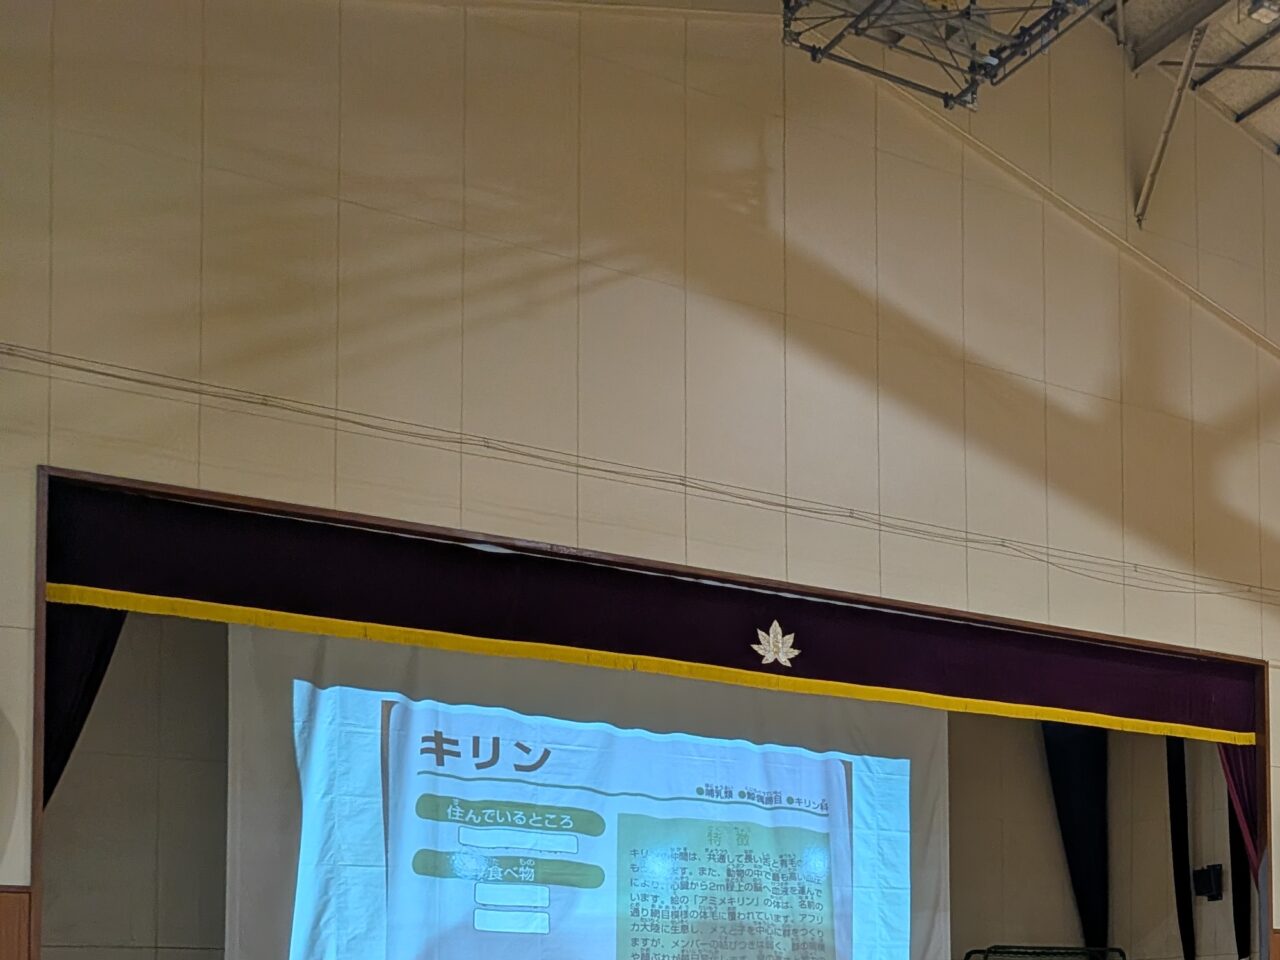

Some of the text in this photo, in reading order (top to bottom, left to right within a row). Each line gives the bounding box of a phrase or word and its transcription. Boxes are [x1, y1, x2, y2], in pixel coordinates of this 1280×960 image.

[420, 729, 551, 773] キリン
[447, 804, 574, 829] 住んでいるところ
[487, 863, 535, 881] 食べ物
